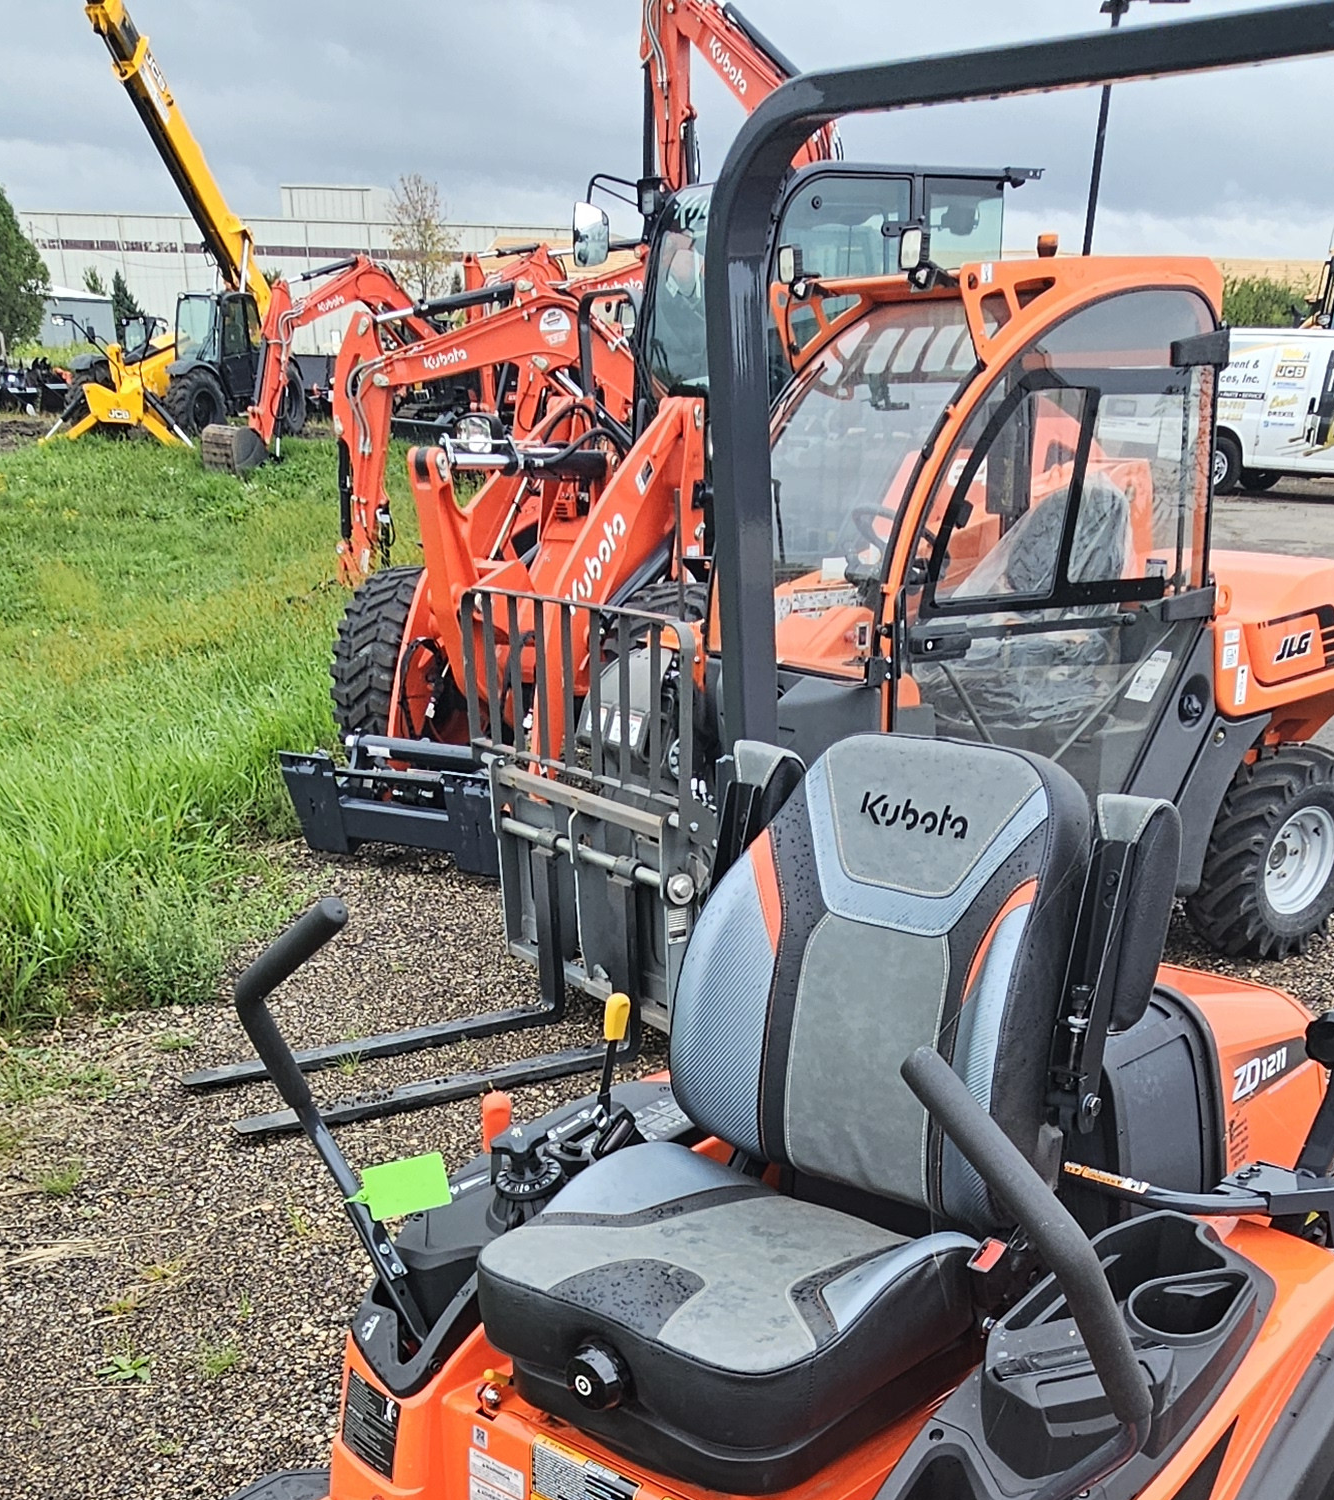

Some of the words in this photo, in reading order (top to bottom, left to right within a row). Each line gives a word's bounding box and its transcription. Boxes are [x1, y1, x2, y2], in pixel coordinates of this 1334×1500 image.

[709, 35, 747, 95] Kubota
[317, 294, 345, 312] Kubota
[423, 348, 467, 369] Kubota
[1253, 360, 1259, 369] &
[1242, 374, 1260, 384] Inc.
[1276, 366, 1305, 378] JCB
[108, 409, 130, 419] JCB
[565, 513, 627, 616] Kubota
[1273, 630, 1313, 663] JLG
[860, 791, 969, 839] Kubota
[1231, 1046, 1287, 1103] ZD1211
